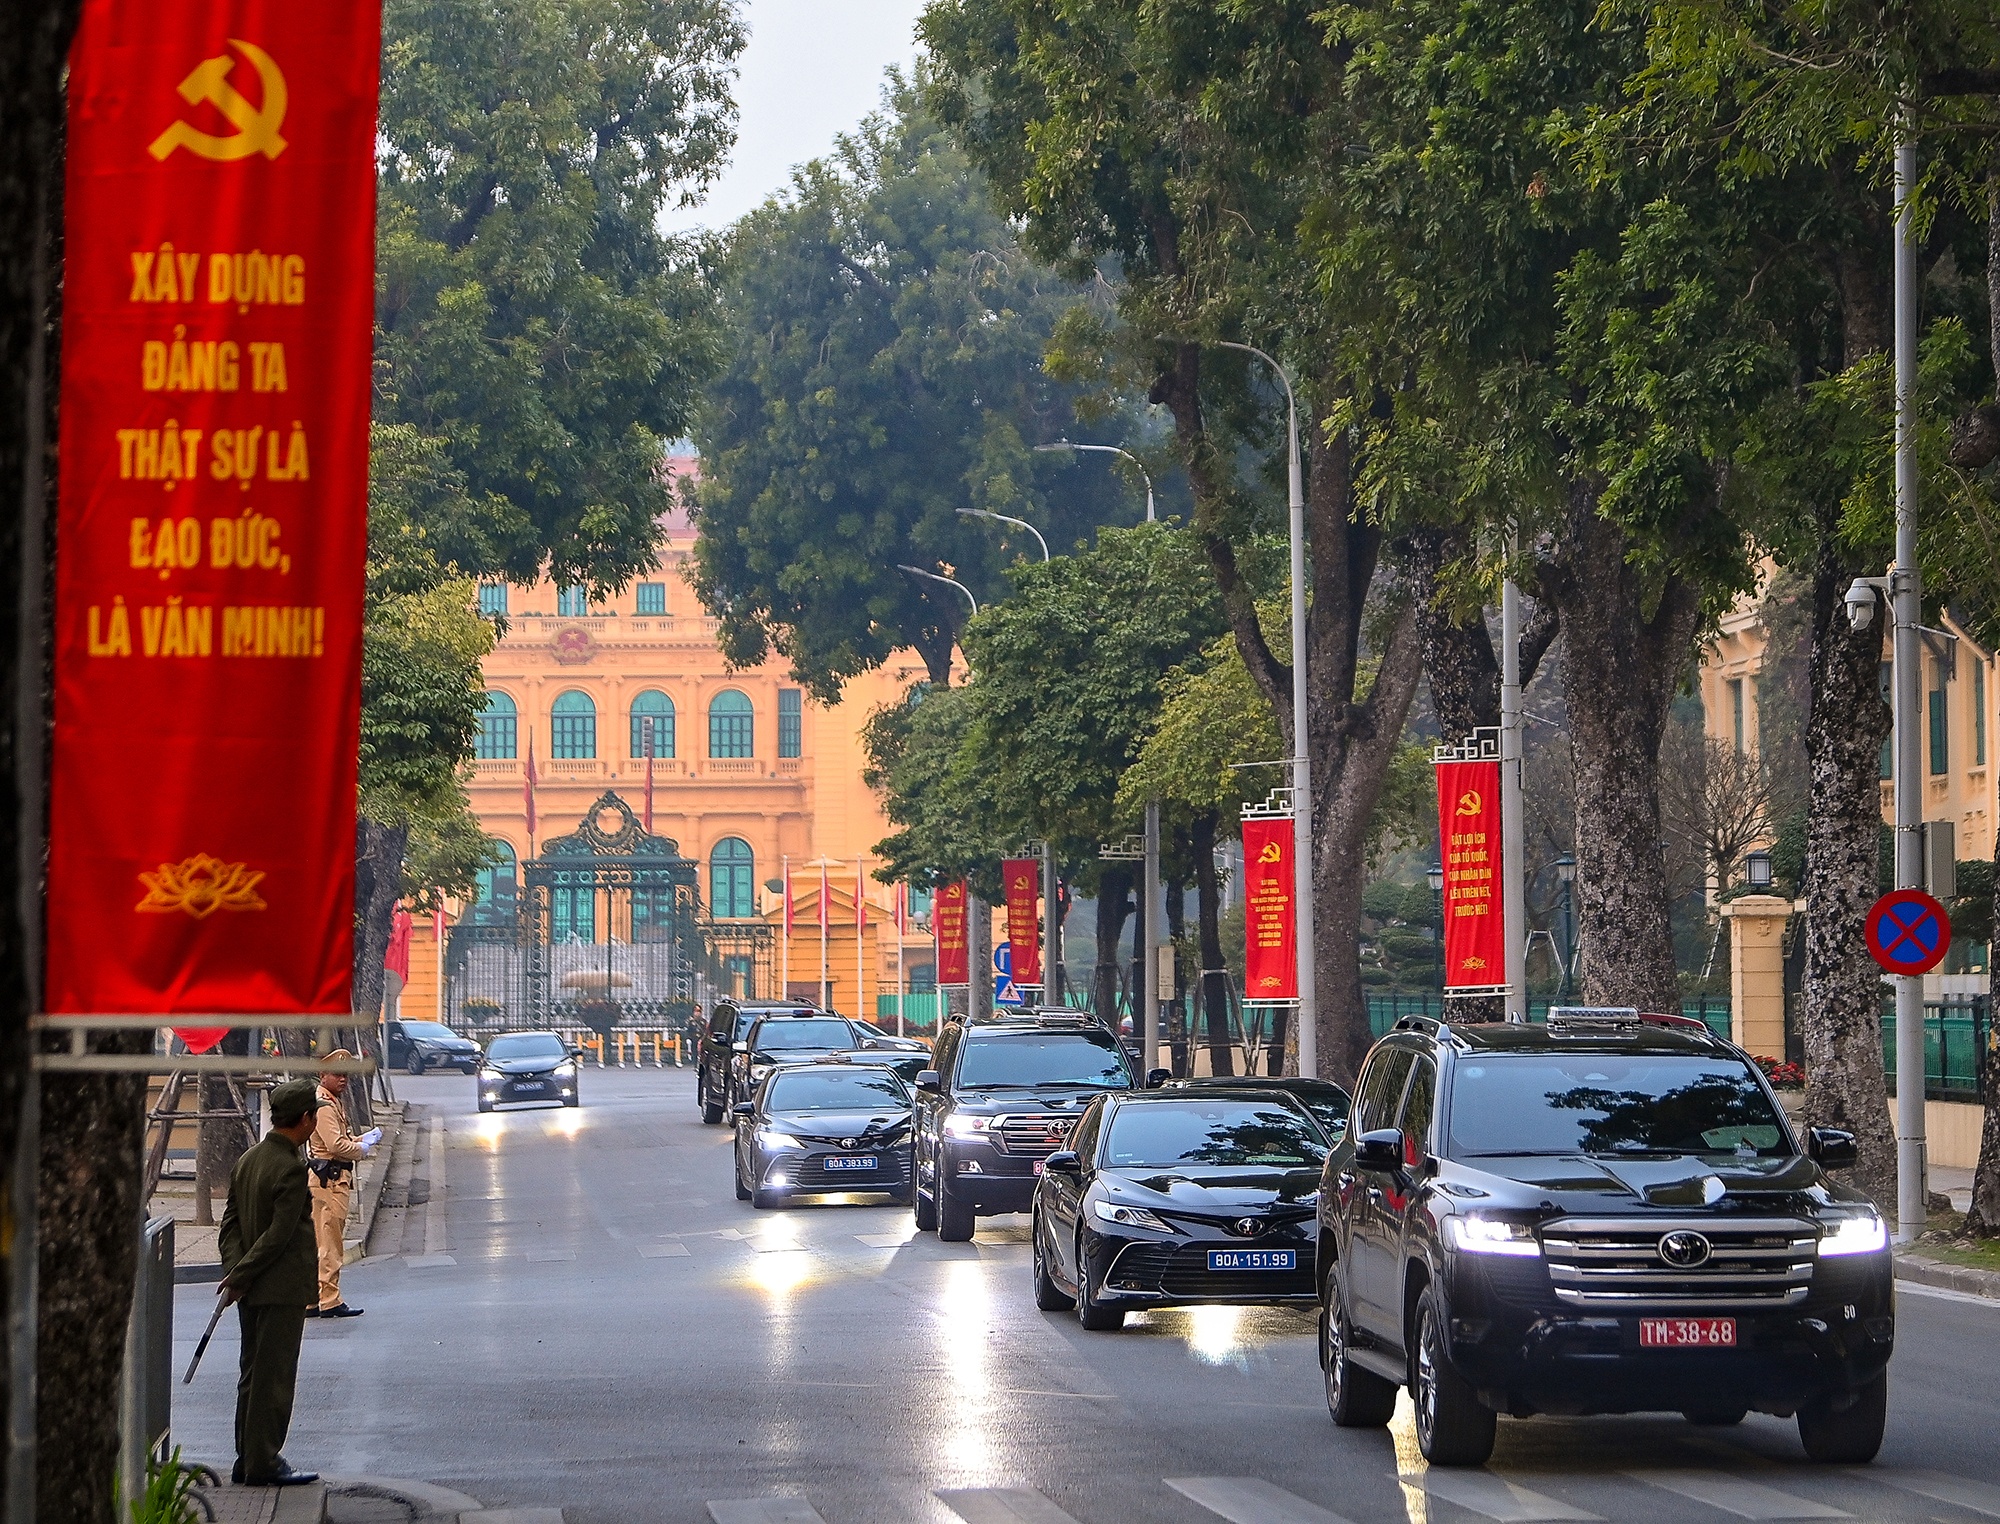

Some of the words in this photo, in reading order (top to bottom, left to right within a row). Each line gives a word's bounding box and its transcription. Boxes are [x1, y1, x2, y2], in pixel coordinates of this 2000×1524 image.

[130, 242, 200, 303] XÂY
[208, 249, 305, 314] DỰNG
[142, 323, 240, 392] ĐẢNG
[248, 342, 288, 392] TA
[116, 418, 203, 492] THẬT
[210, 425, 263, 492] SỰ
[266, 420, 310, 481] LÀ
[210, 507, 291, 576] ĐỨC,
[88, 594, 132, 657] LÀ
[140, 595, 213, 657] VĂN
[222, 606, 325, 657] MINH!
[1215, 1253, 1288, 1267] 80A-151.99
[1643, 1320, 1732, 1344] TM-38-68
